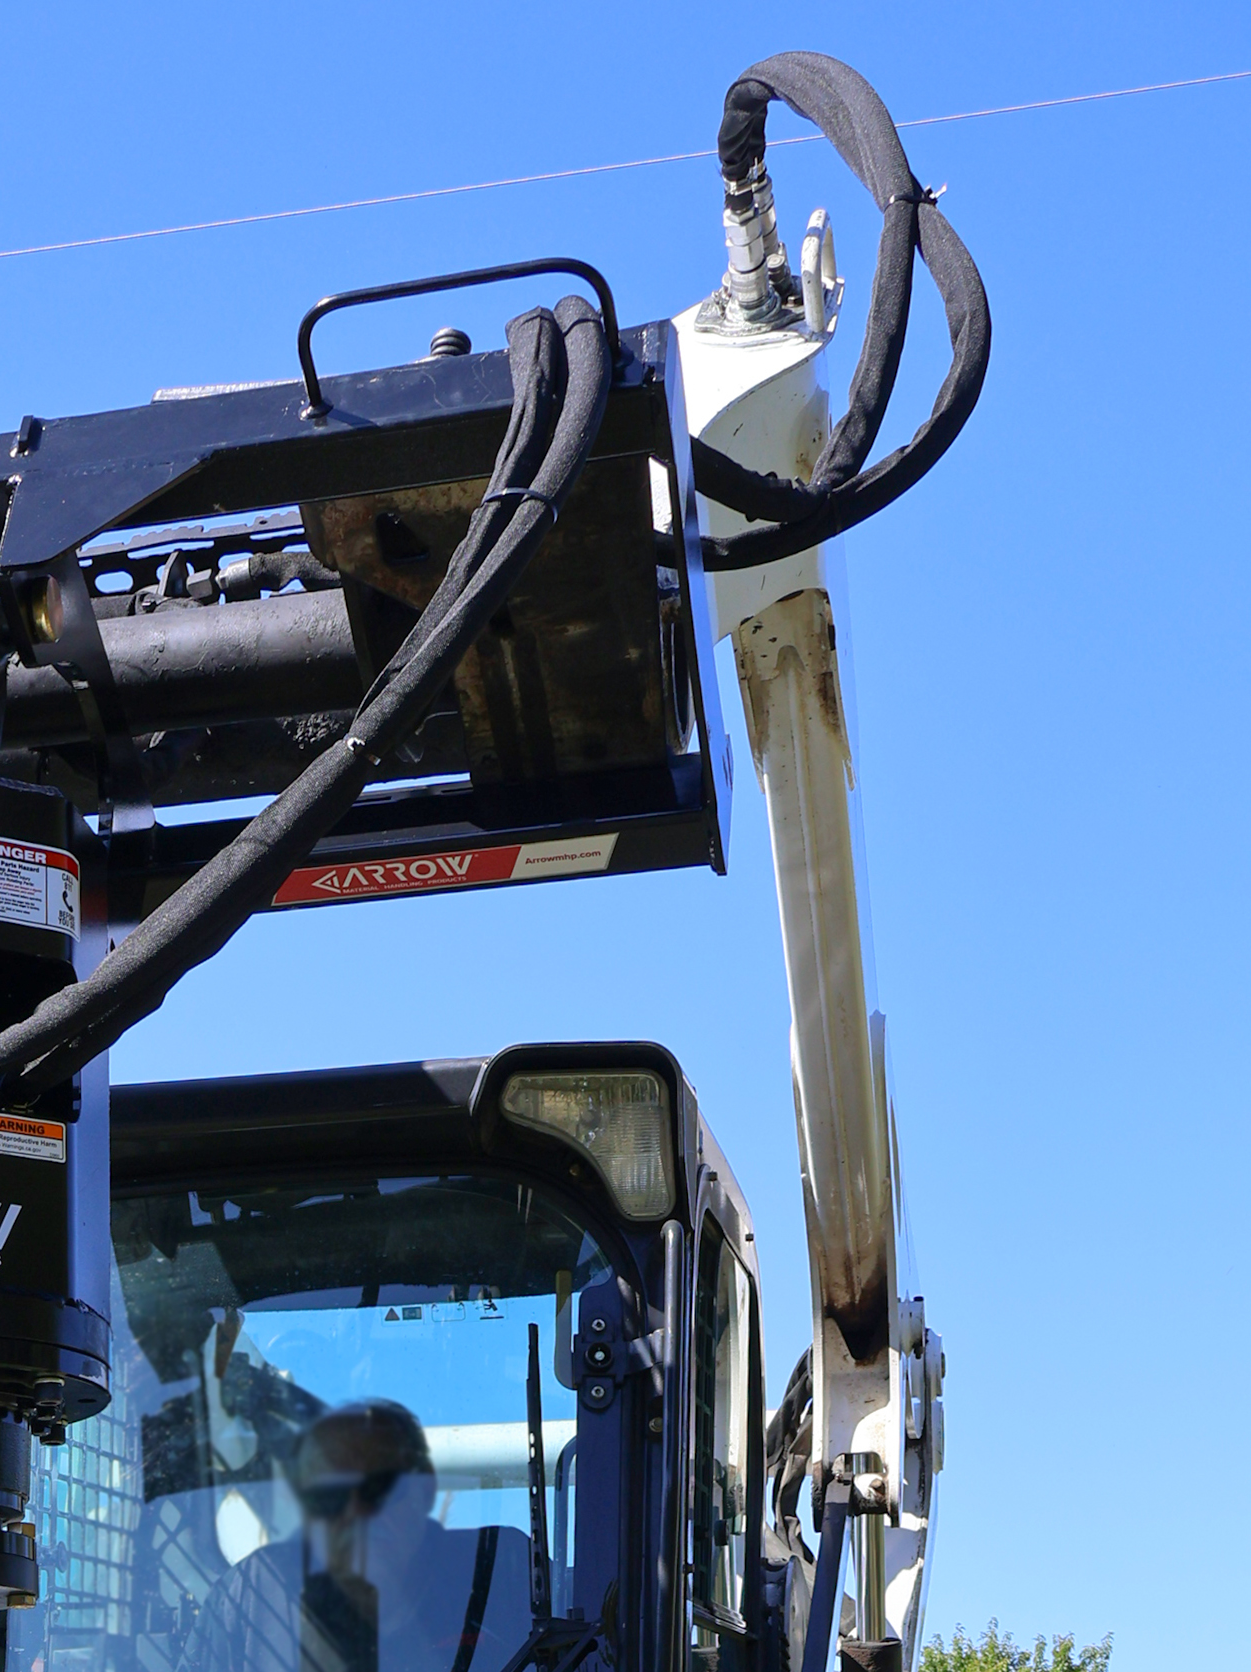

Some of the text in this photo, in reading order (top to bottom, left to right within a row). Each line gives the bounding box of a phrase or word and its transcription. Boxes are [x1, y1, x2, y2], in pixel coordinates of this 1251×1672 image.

[525, 850, 601, 865] Arrowmhp.com
[1, 860, 17, 869] Parts
[18, 863, 40, 873] Hazard
[342, 853, 473, 888] ARROW
[61, 873, 74, 885] CALL
[342, 875, 467, 894] MATERIAL HANDLING PRODUCTS
[40, 1139, 57, 1148] Harm
